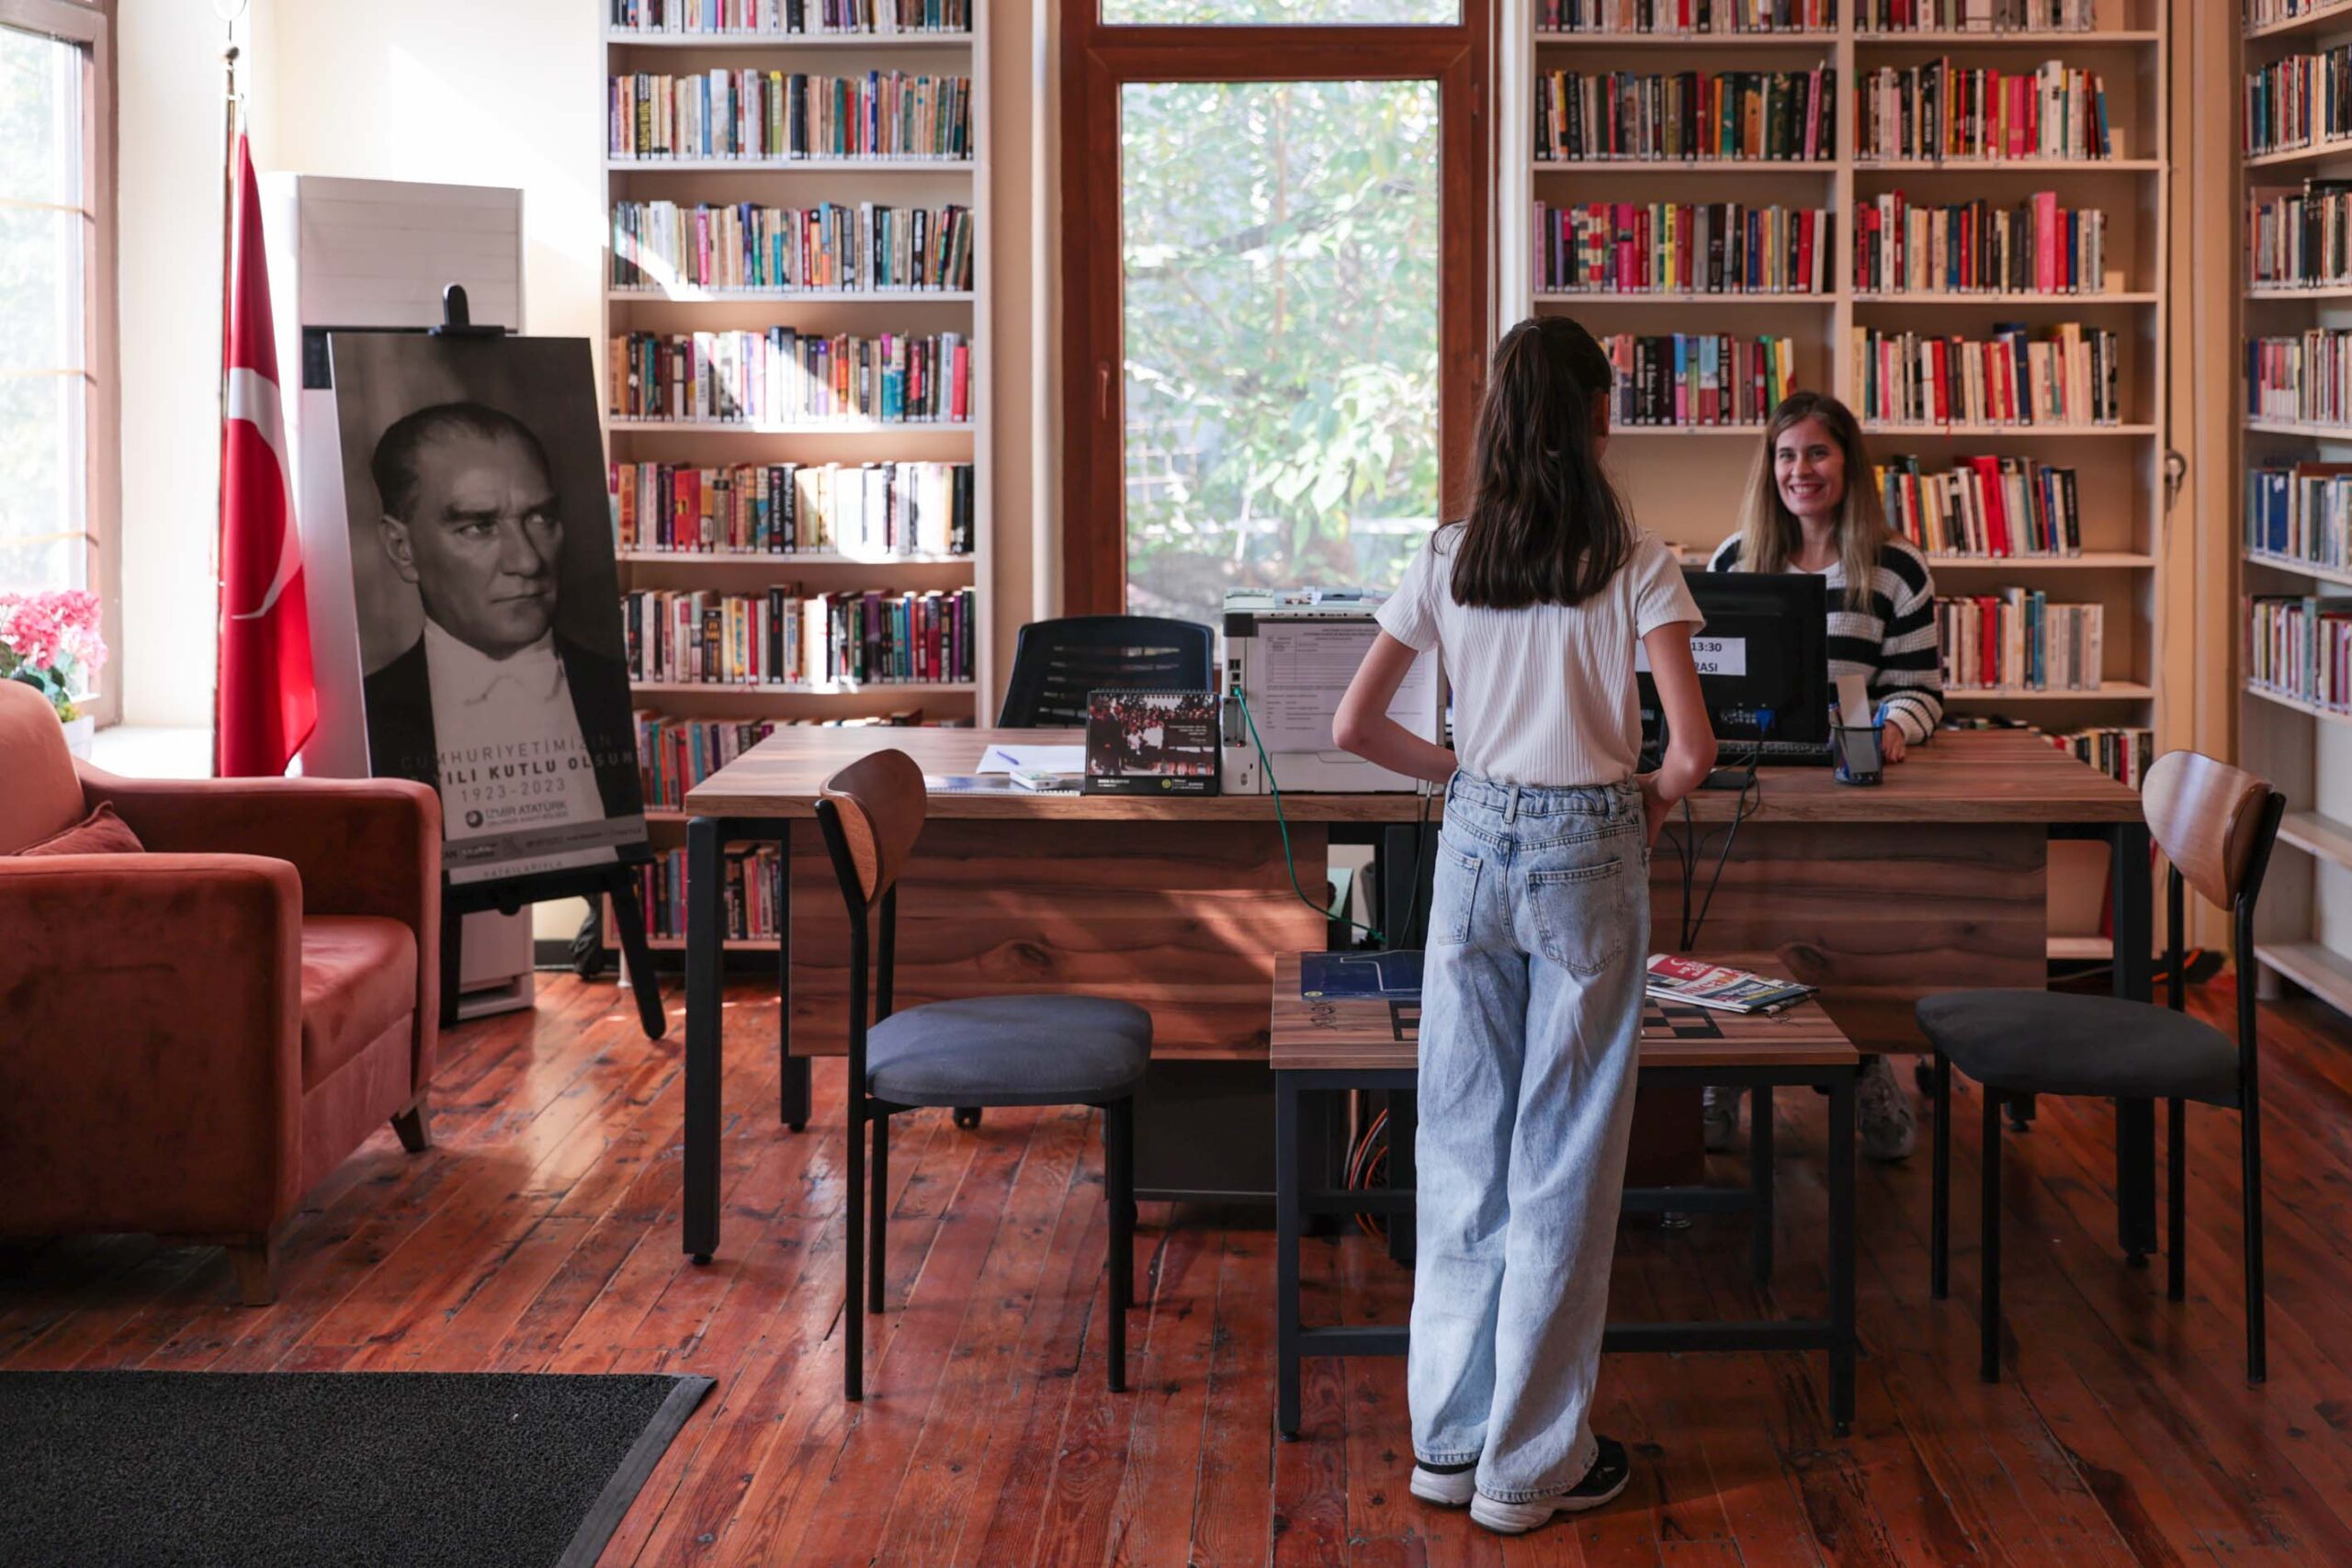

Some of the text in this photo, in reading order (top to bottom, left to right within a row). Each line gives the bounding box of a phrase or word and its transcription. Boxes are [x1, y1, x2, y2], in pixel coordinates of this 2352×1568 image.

[1691, 642, 1723, 652] 13:30
[489, 760, 556, 780] KUTLU
[568, 750, 633, 770] OLSUN
